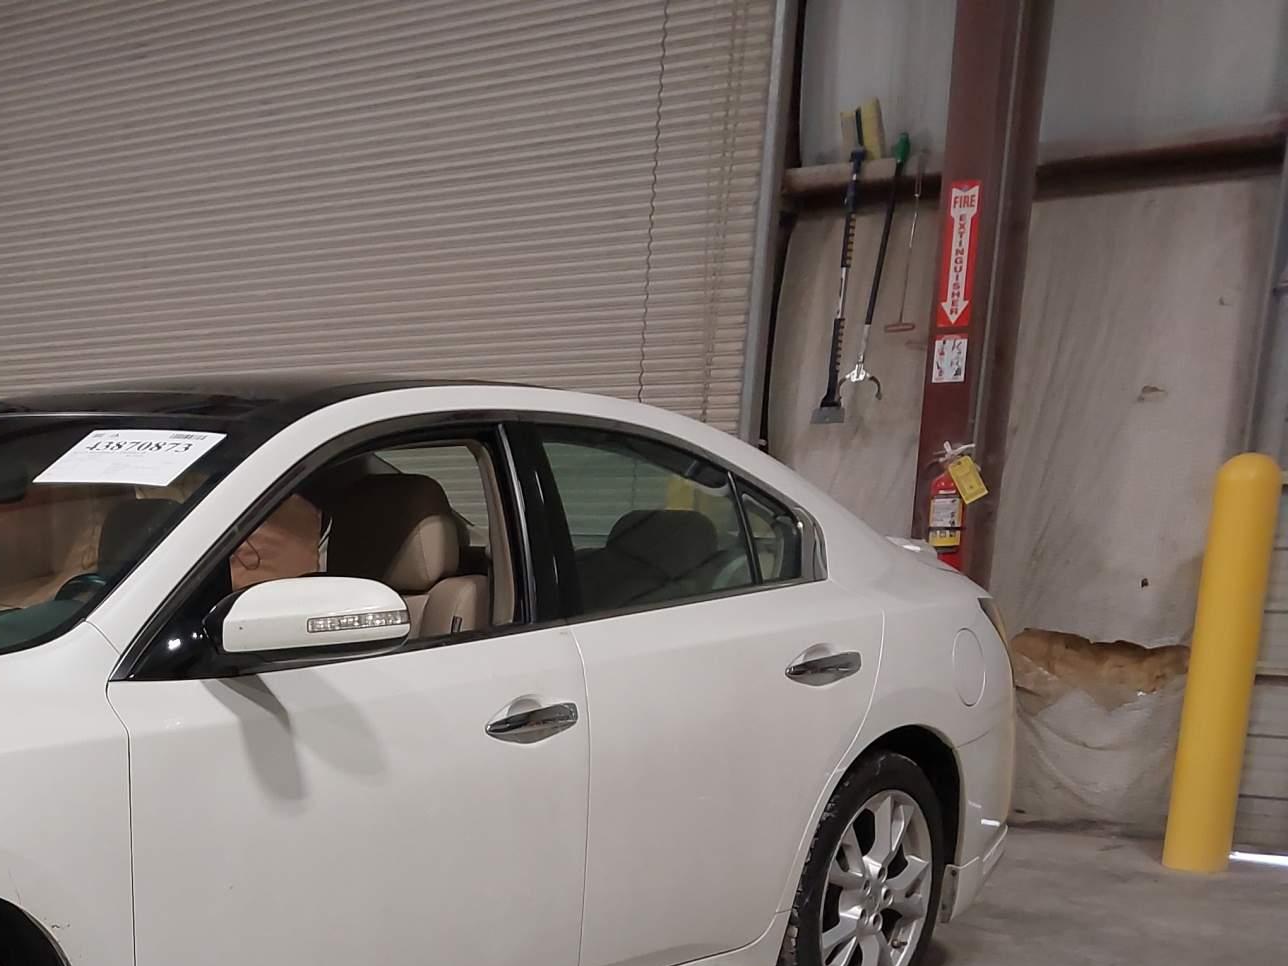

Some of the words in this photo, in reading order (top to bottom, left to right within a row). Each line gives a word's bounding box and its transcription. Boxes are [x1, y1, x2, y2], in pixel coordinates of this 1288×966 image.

[953, 195, 976, 209] FIRE
[950, 214, 967, 315] EXTINGUISHER
[85, 440, 193, 453] 43870873
